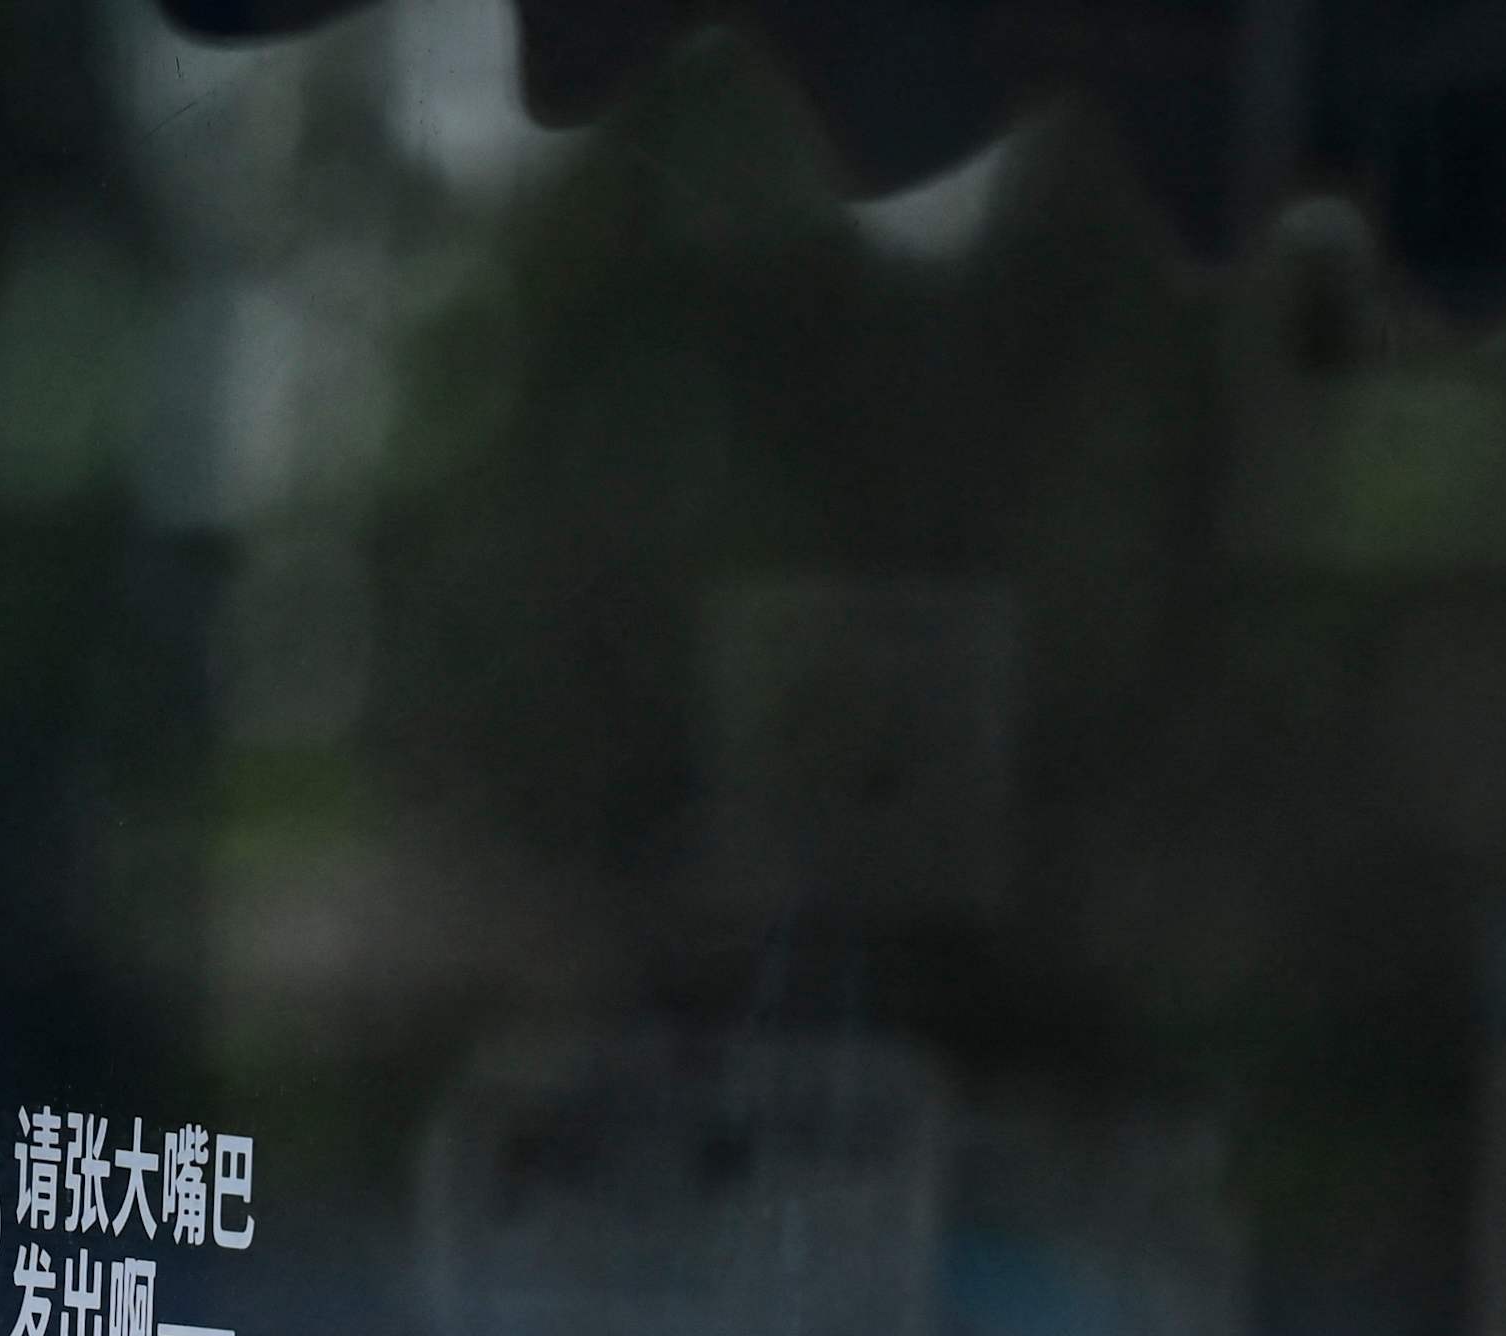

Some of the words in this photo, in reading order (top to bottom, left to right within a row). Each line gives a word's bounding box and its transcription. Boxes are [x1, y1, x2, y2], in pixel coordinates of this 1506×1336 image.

[13, 1104, 256, 1251] 请张大嘴巴
